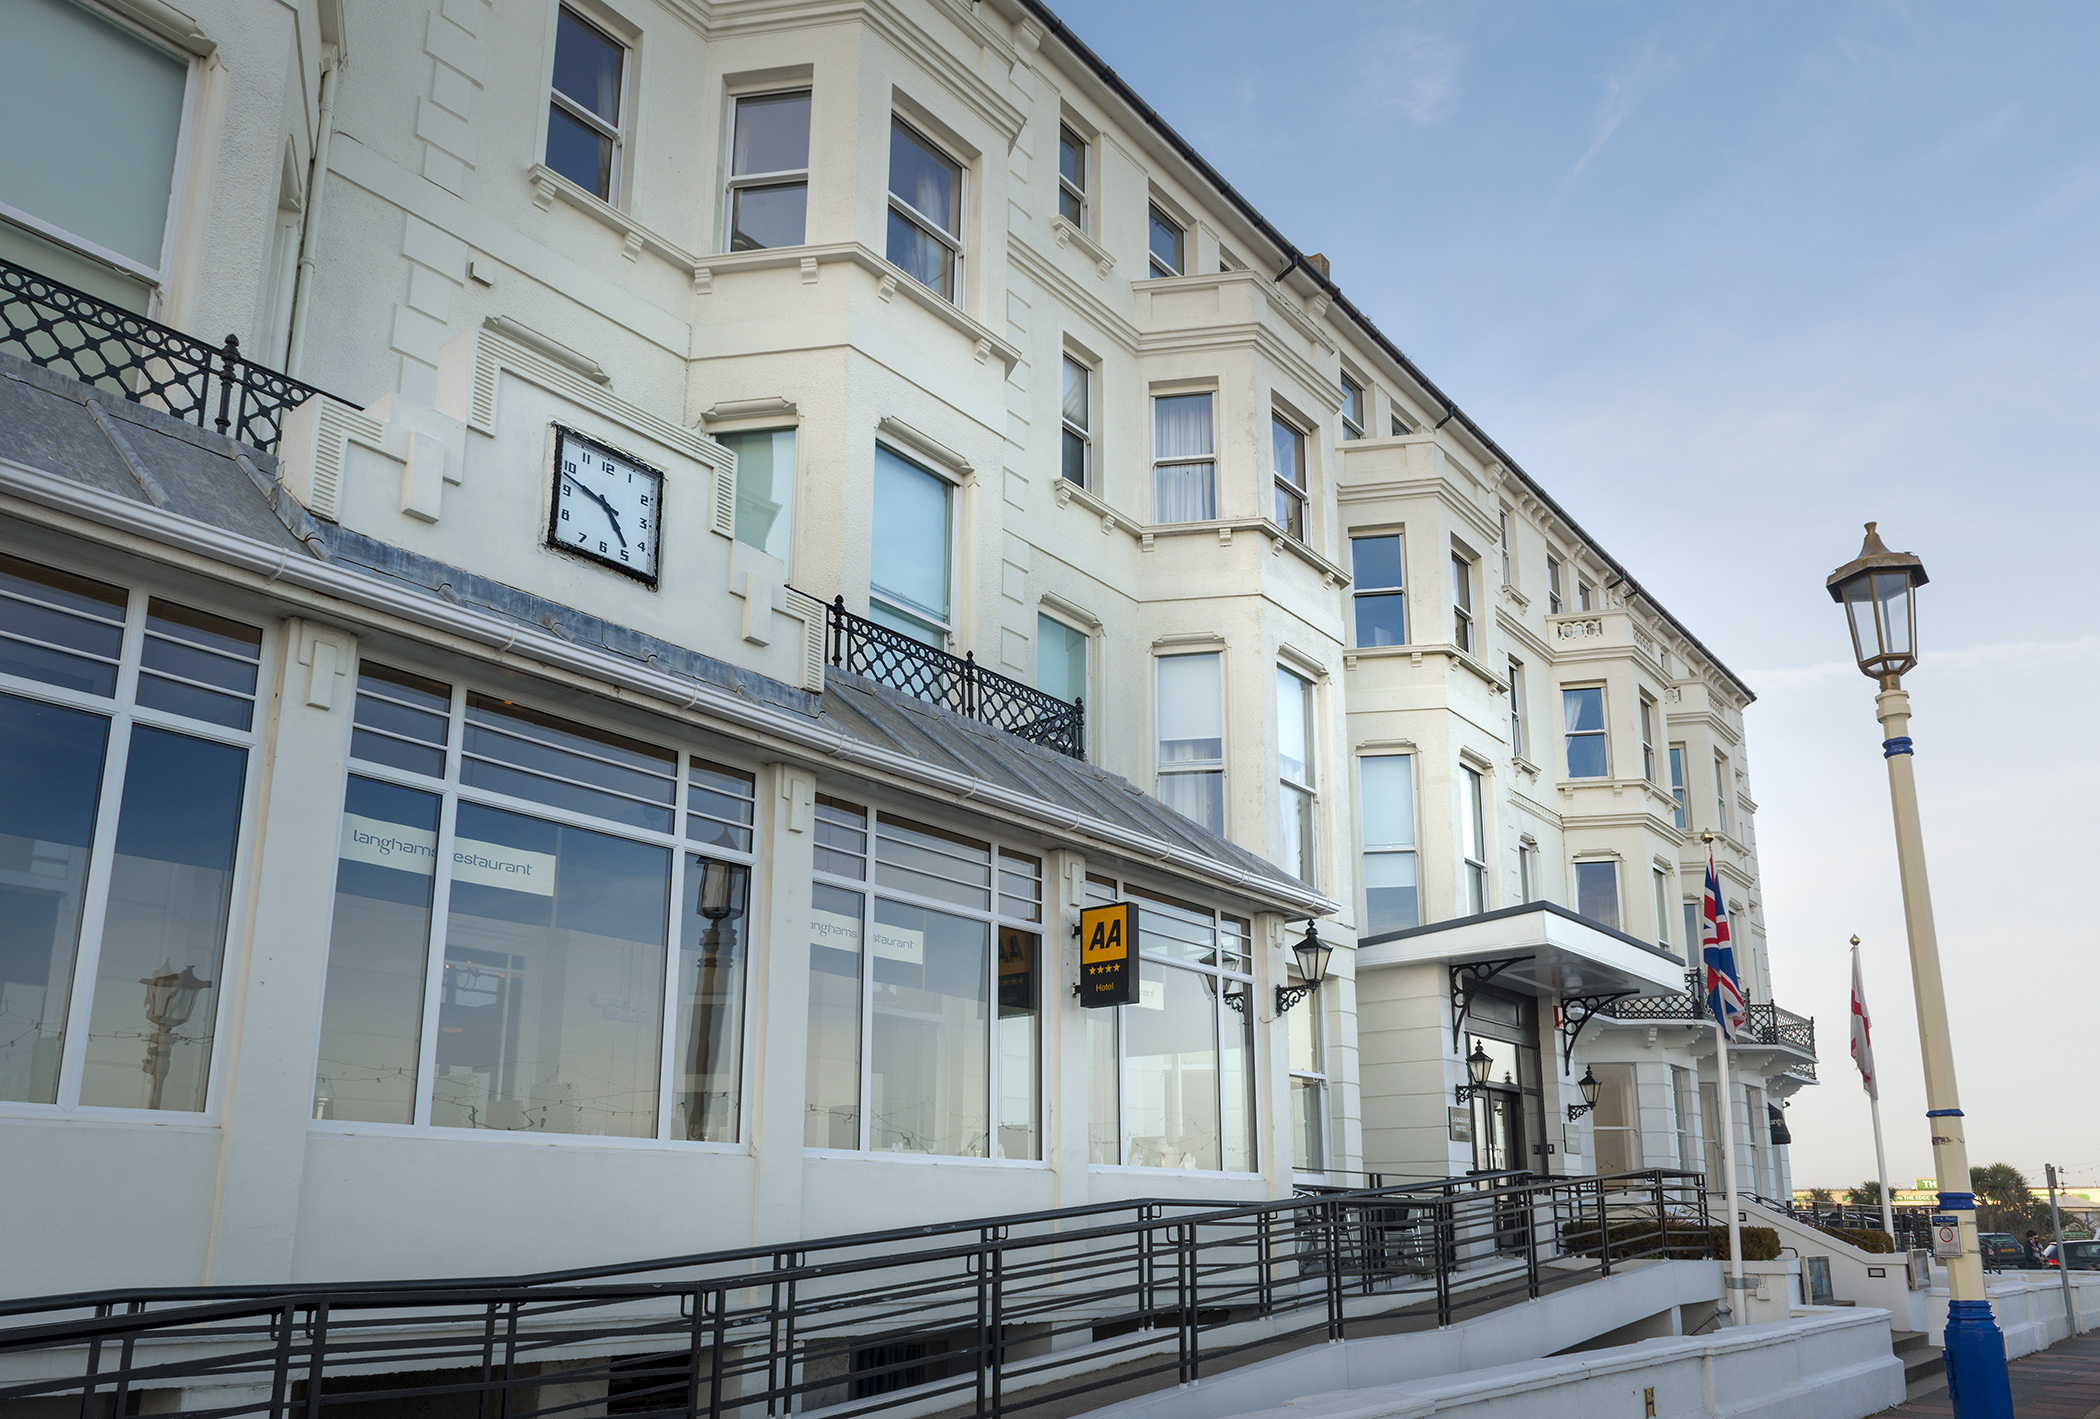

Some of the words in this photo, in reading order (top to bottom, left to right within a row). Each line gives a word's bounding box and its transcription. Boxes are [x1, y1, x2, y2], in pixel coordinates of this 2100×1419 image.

[582, 452, 591, 465] 11
[564, 460, 577, 475] 10
[601, 461, 615, 476] 12
[627, 473, 632, 483] 1
[563, 484, 571, 497] 9
[640, 494, 649, 506] 2
[561, 508, 570, 522] 8
[639, 517, 647, 530] 3
[578, 532, 588, 543] 7
[599, 540, 608, 554] 6
[637, 541, 646, 553] 4
[620, 549, 629, 562] 5
[452, 851, 532, 876] estaurant
[873, 934, 914, 949] staurant
[1088, 919, 1121, 951] AA
[1095, 982, 1114, 992] Hotel
[1922, 1180, 1936, 1188] TH
